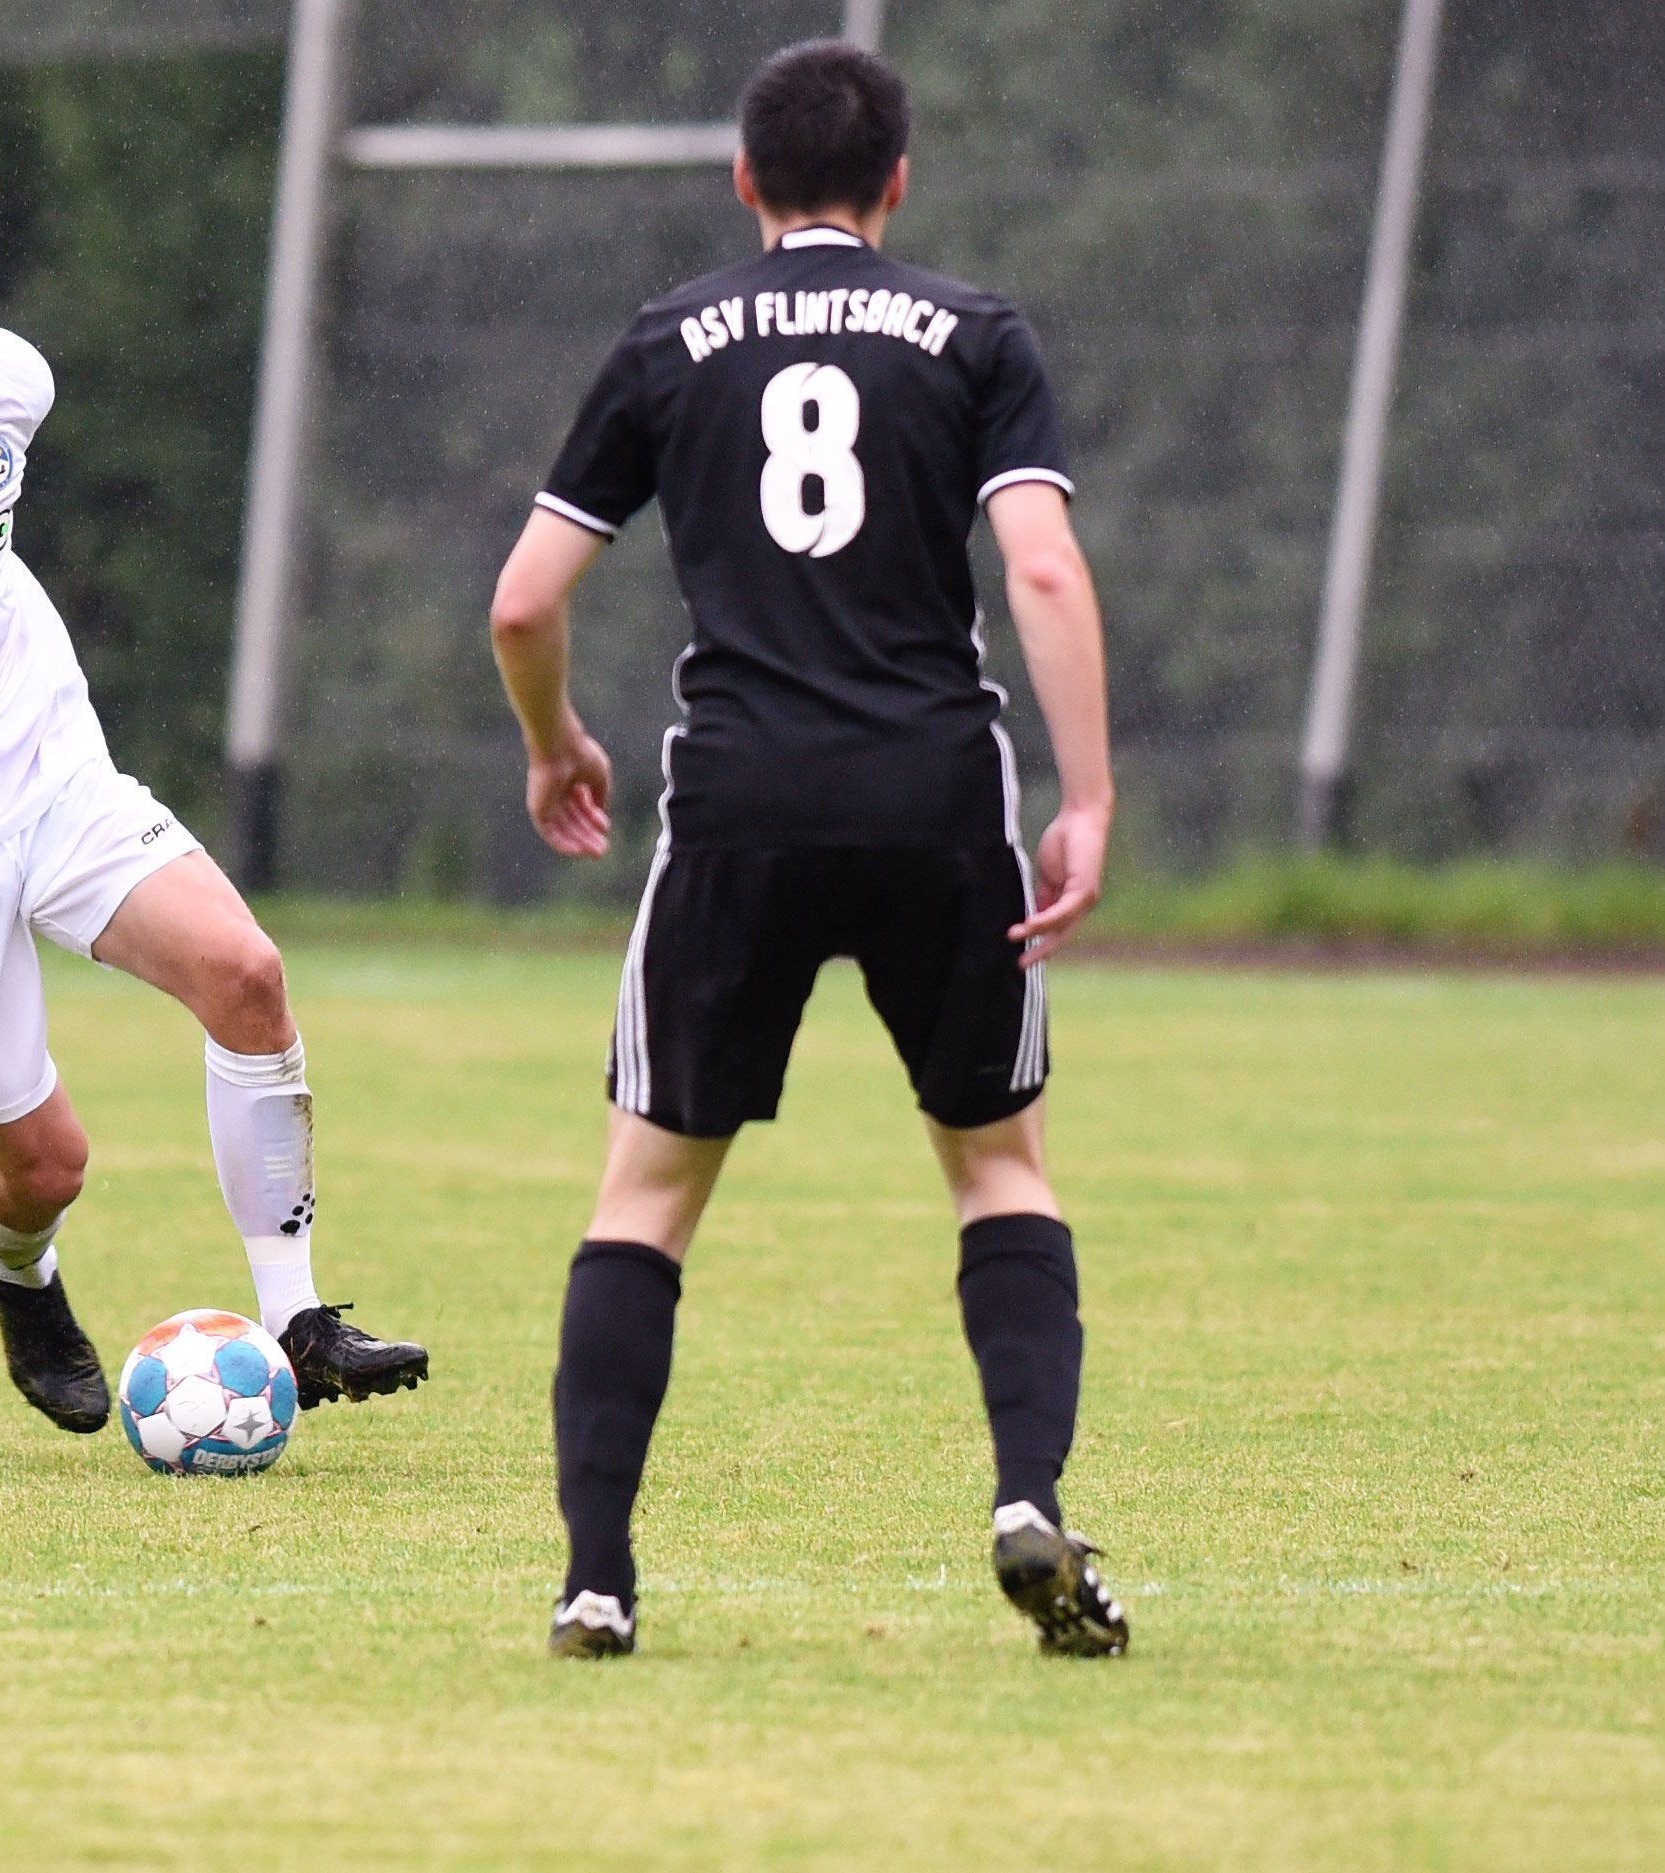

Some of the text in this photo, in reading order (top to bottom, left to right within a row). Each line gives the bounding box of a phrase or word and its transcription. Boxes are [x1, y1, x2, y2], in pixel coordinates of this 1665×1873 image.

[680, 288, 960, 363] ASV FLINTSBACH
[760, 361, 866, 559] 8
[192, 1441, 285, 1470] DERBYST
